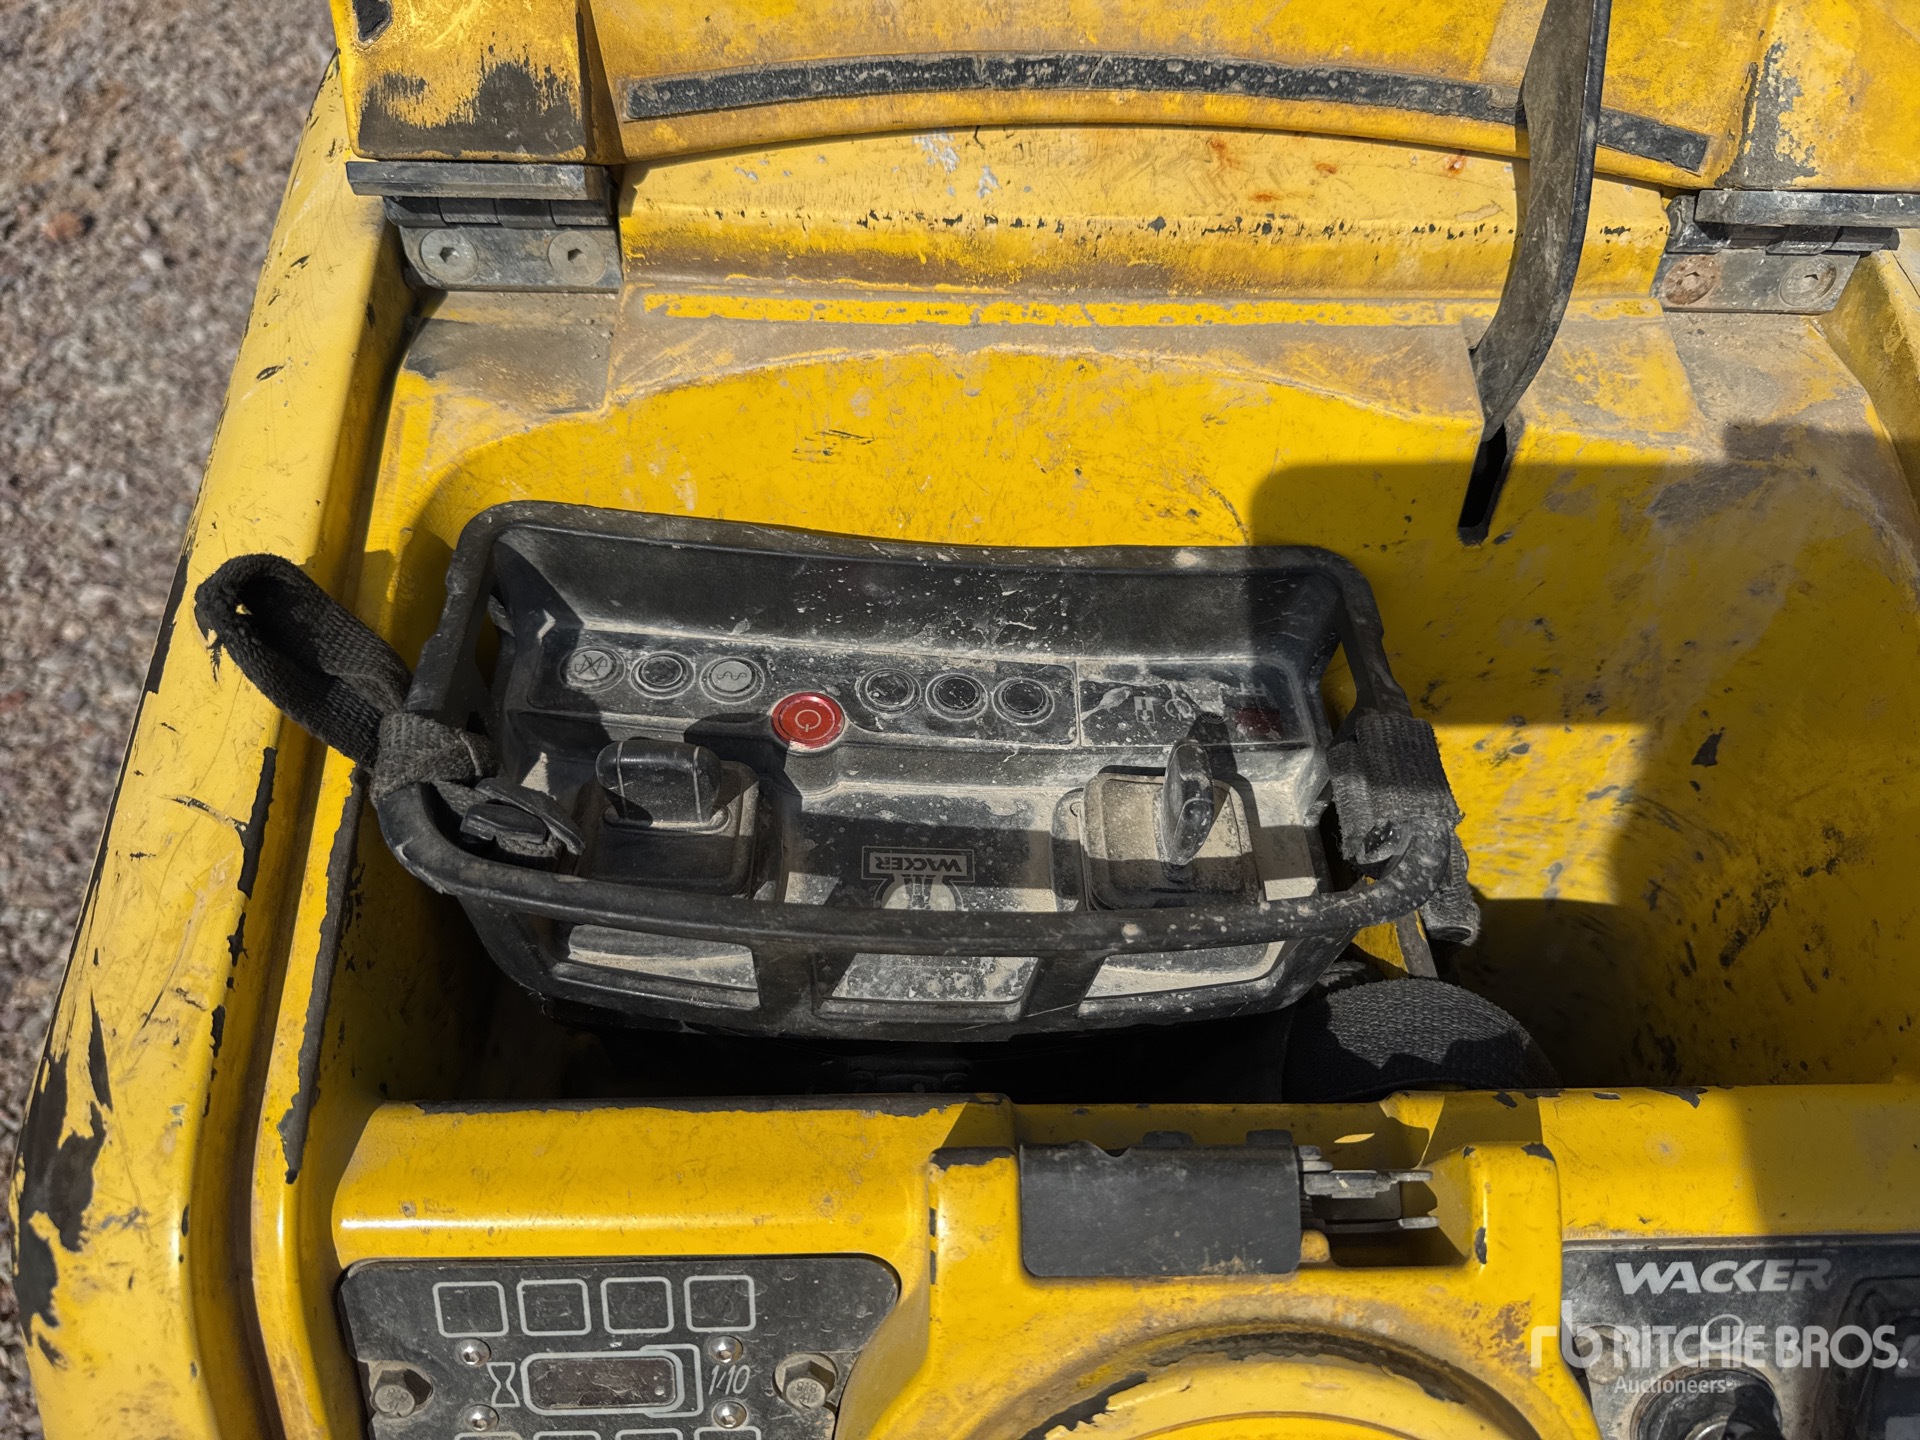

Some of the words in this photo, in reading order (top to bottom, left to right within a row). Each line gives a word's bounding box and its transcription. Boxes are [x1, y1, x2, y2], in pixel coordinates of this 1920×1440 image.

[875, 856, 963, 872] WACKER
[1615, 1258, 1832, 1295] WACKER
[708, 1364, 751, 1396] 1/10
